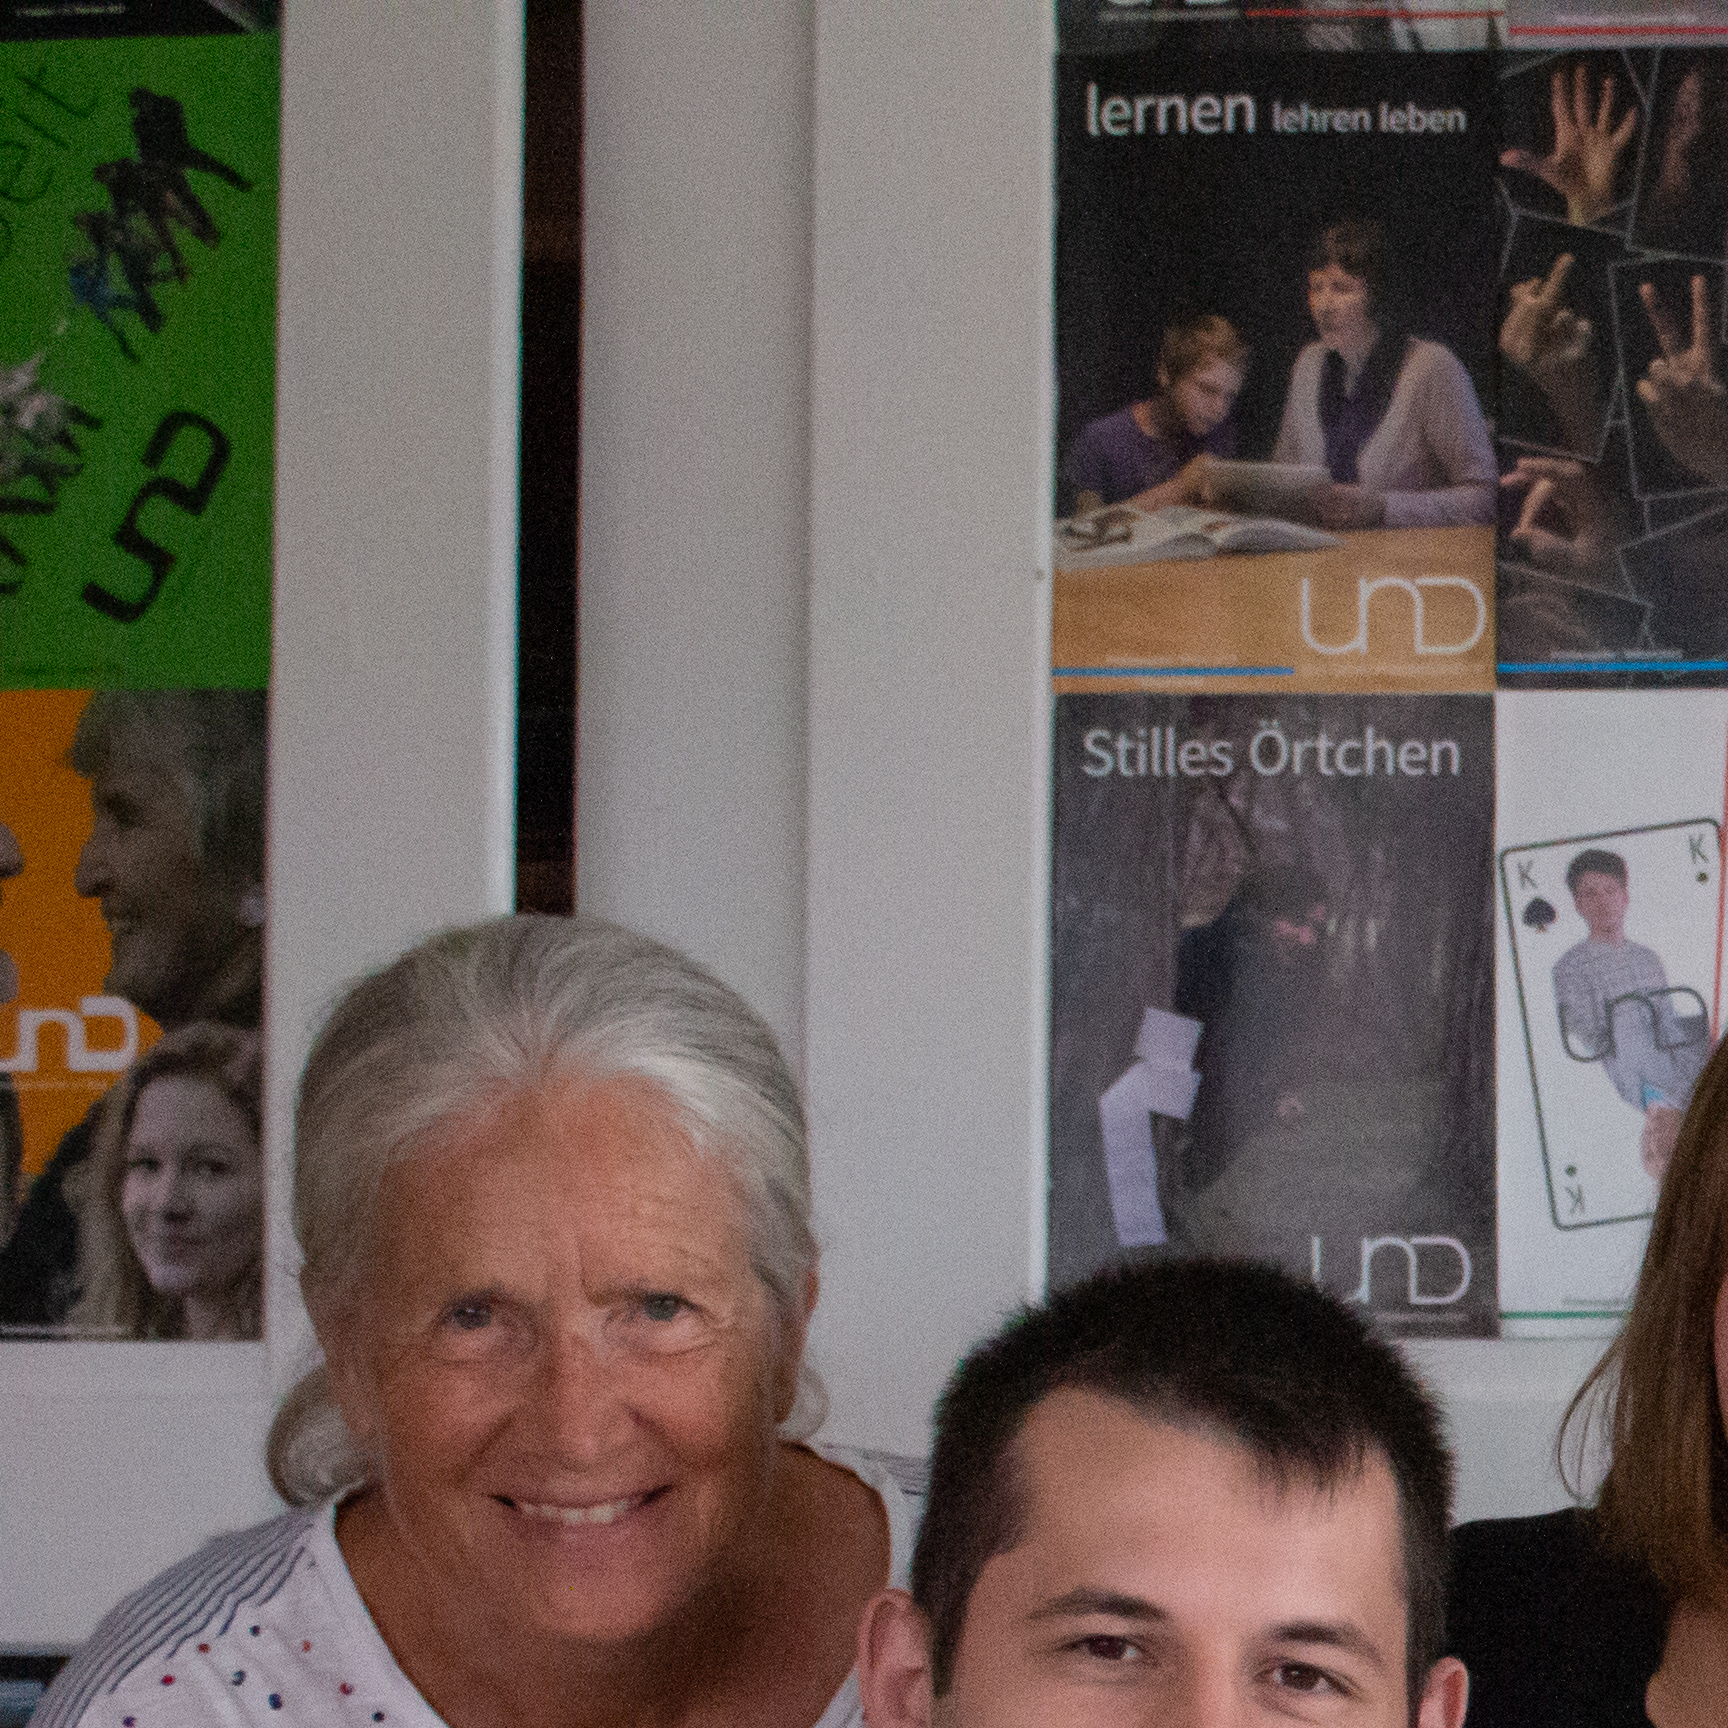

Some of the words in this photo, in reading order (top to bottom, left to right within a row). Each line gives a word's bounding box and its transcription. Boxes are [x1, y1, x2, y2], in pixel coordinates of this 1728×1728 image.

[1085, 82, 1257, 137] lernen
[1271, 102, 1372, 133] lehren
[1379, 104, 1467, 133] leben
[1082, 729, 1235, 777] Stilles
[1249, 718, 1462, 777] Örtchen
